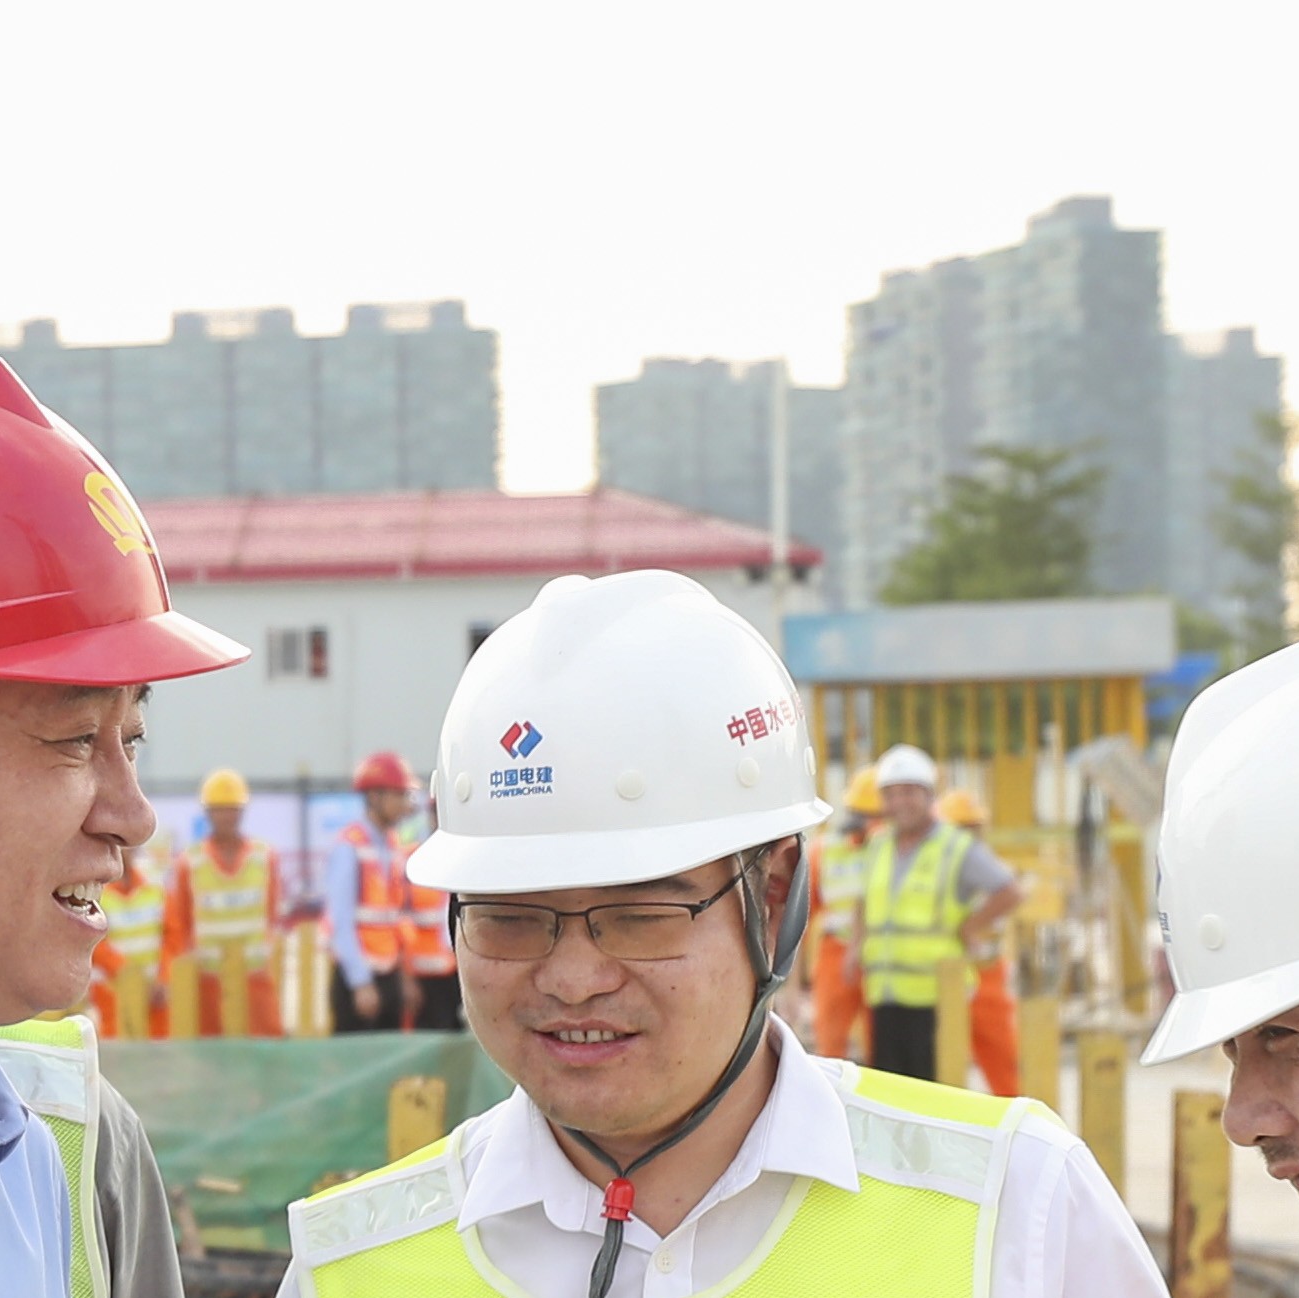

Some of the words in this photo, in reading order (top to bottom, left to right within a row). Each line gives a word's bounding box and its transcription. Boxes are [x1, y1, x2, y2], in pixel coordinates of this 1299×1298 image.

[490, 766, 553, 787] 中国电建
[490, 785, 553, 799] POWERCHINA
